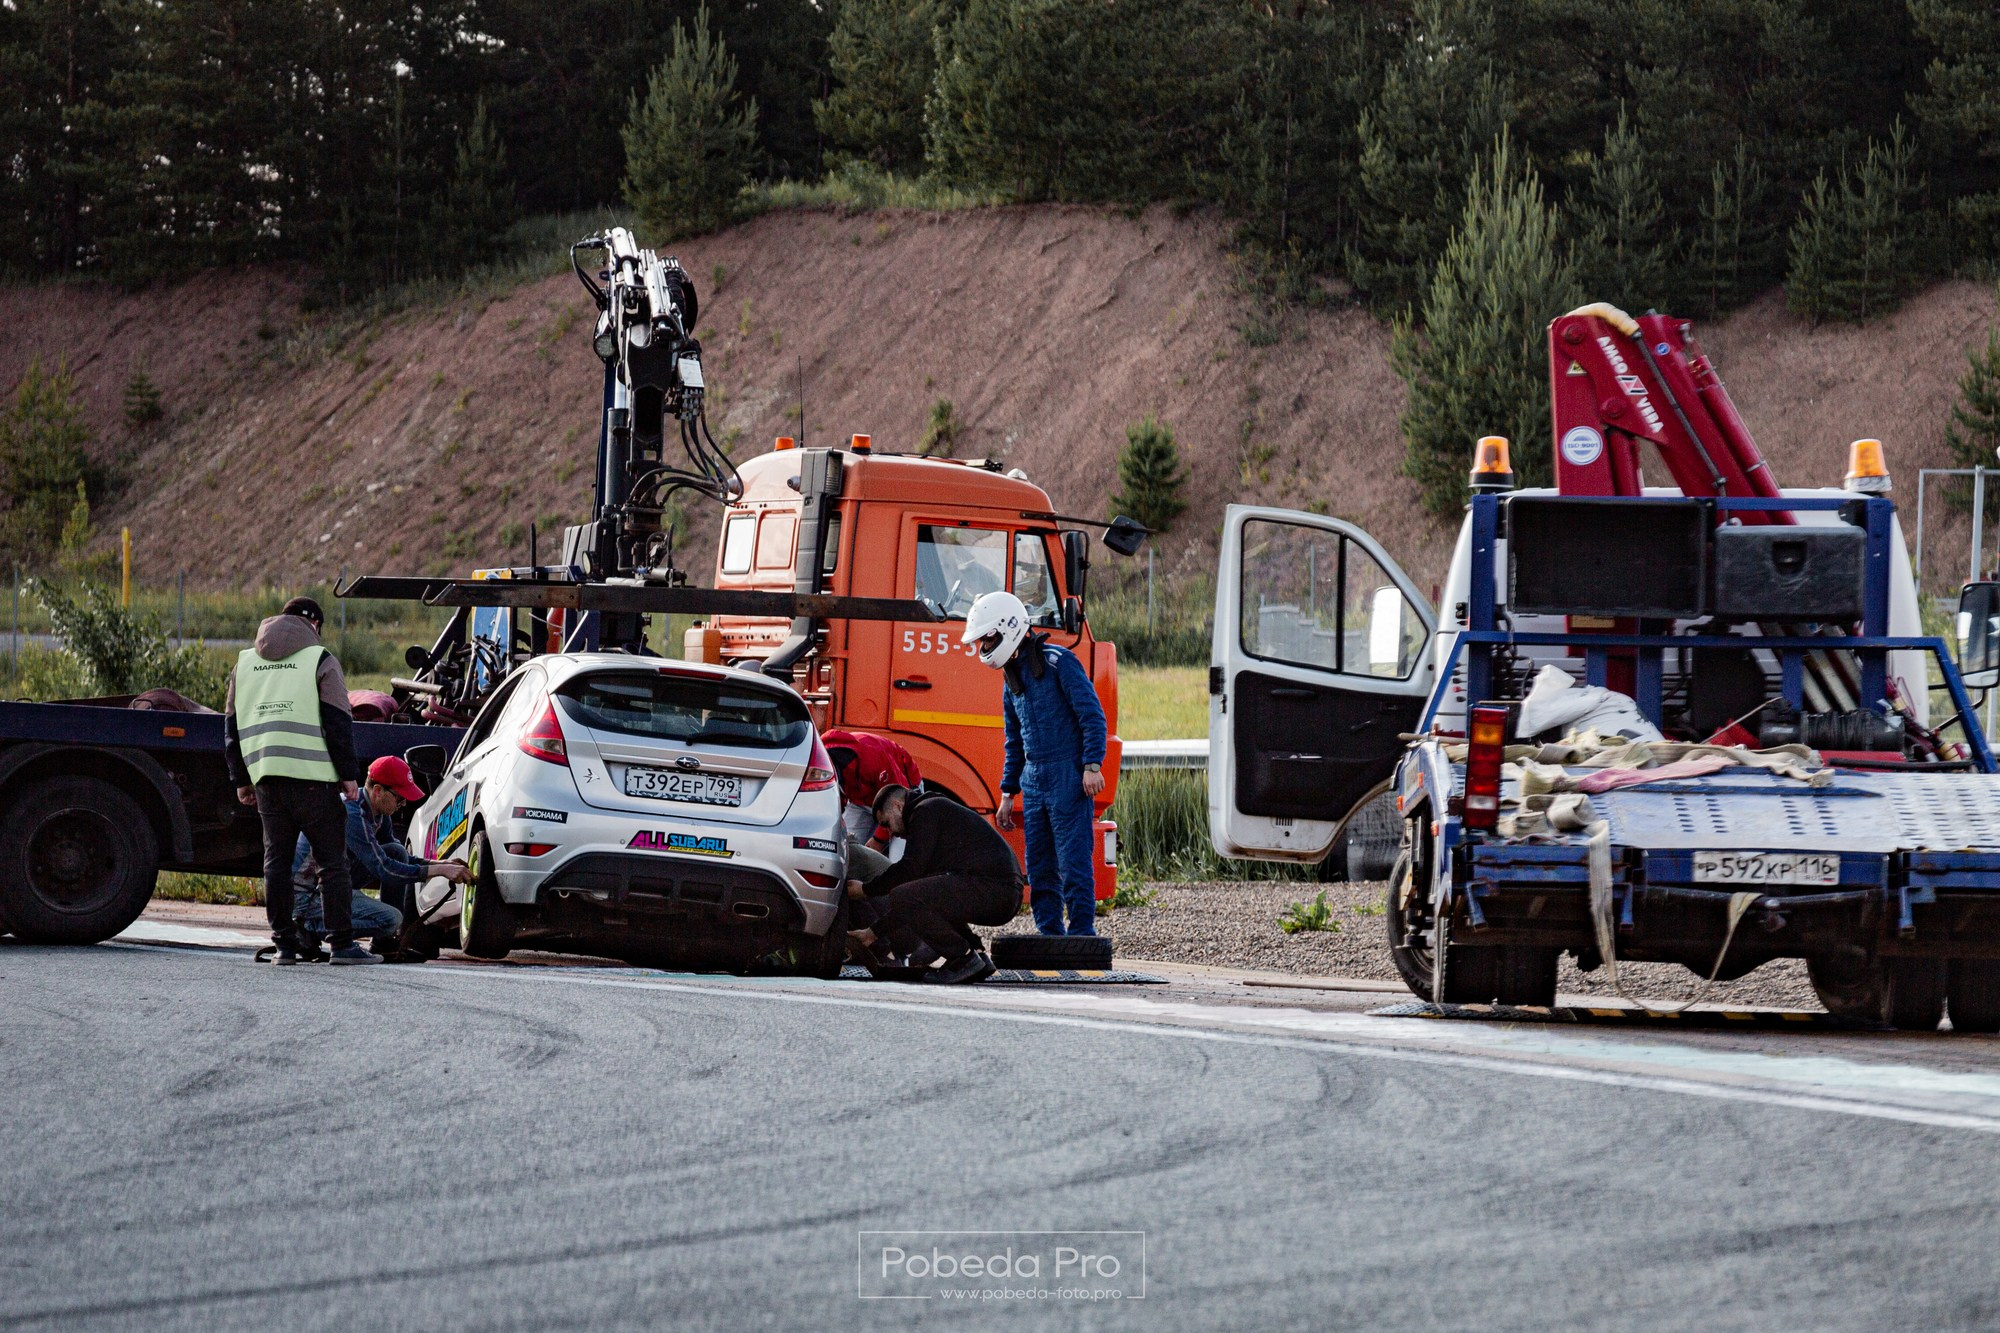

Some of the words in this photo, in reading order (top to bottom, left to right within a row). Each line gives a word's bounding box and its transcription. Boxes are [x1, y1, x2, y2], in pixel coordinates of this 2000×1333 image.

[1597, 336, 1629, 374] AMCO
[1636, 396, 1664, 433] VEBA
[253, 663, 298, 671] MARSHAL
[708, 777, 735, 793] 799
[525, 809, 563, 821] YOKOHAMA
[629, 831, 669, 850] ALL
[669, 834, 725, 851] SUBARU
[808, 840, 836, 851] YOKOHAMA
[1799, 857, 1833, 874] 116
